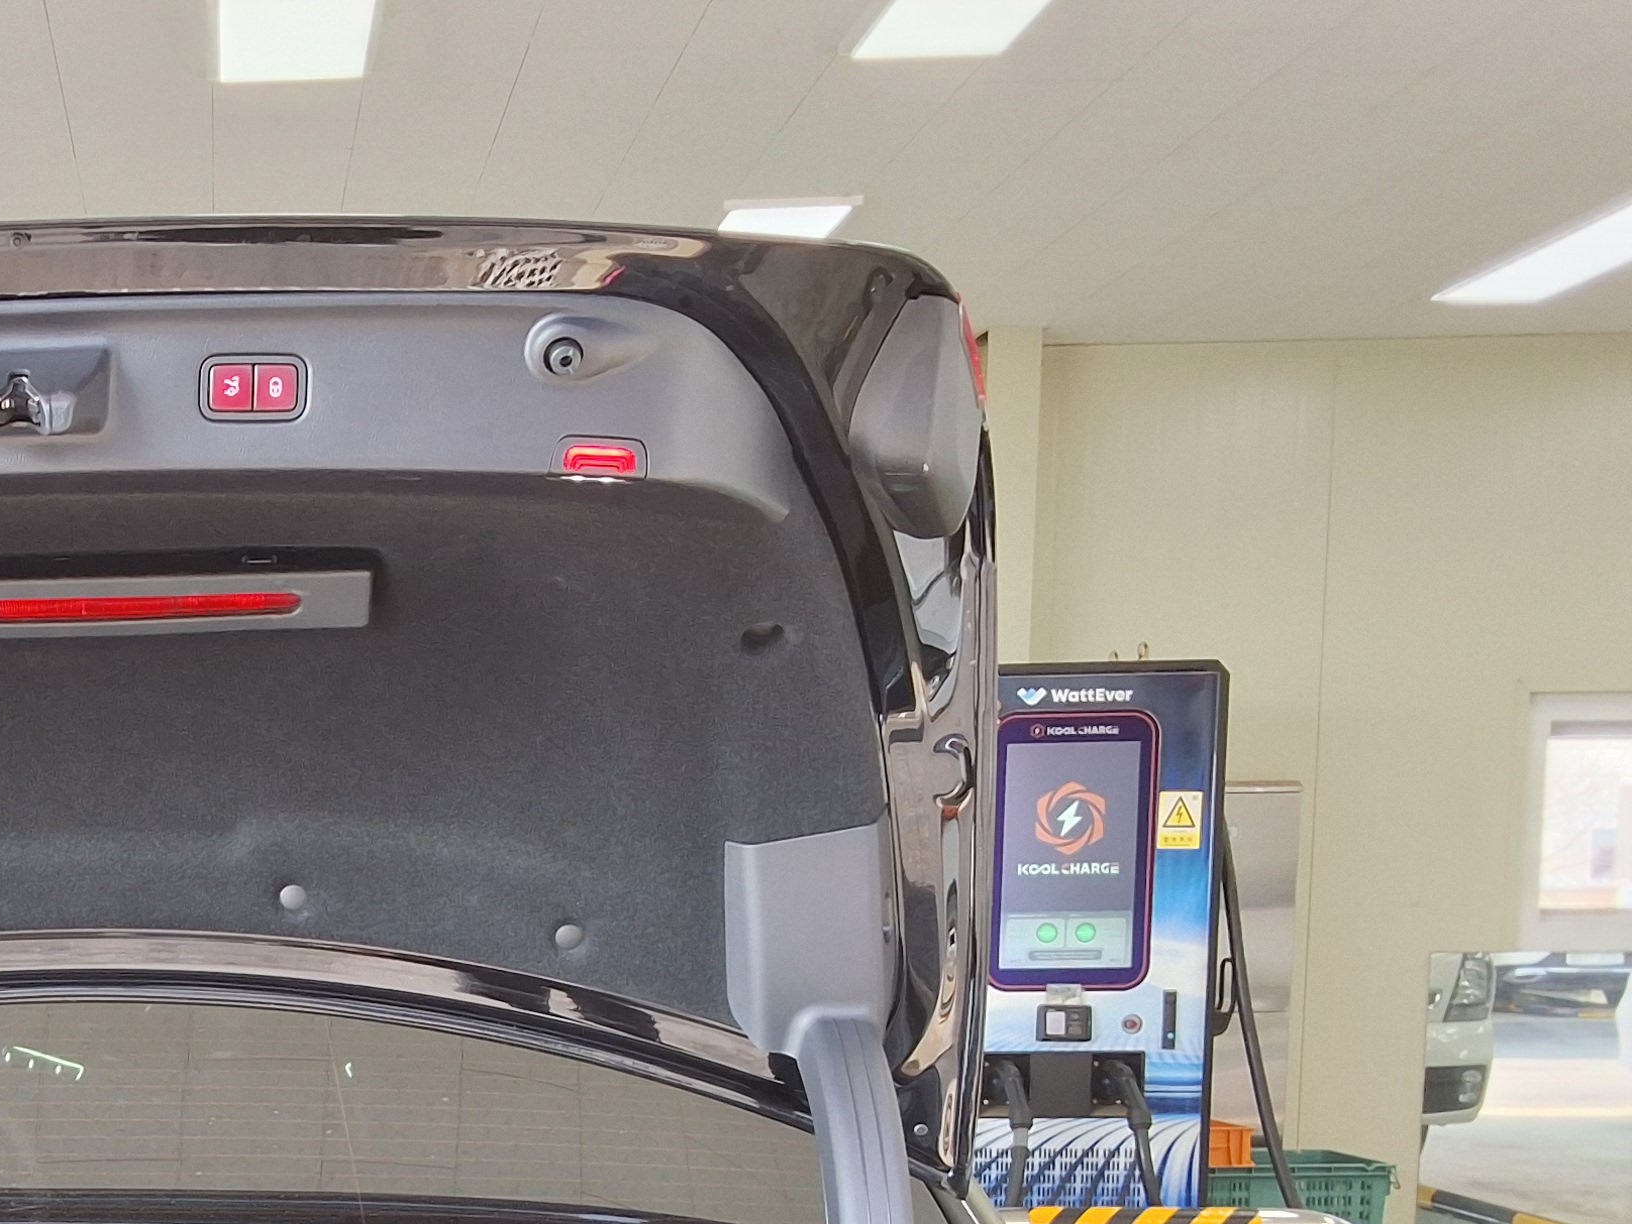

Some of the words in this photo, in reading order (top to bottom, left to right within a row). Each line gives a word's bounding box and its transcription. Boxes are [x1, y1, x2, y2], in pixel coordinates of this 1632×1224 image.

[1050, 687, 1134, 703] WattEver
[1046, 726, 1077, 736] KOOL
[1017, 863, 1060, 876] KOOL
[1061, 862, 1120, 875] CHARGE
